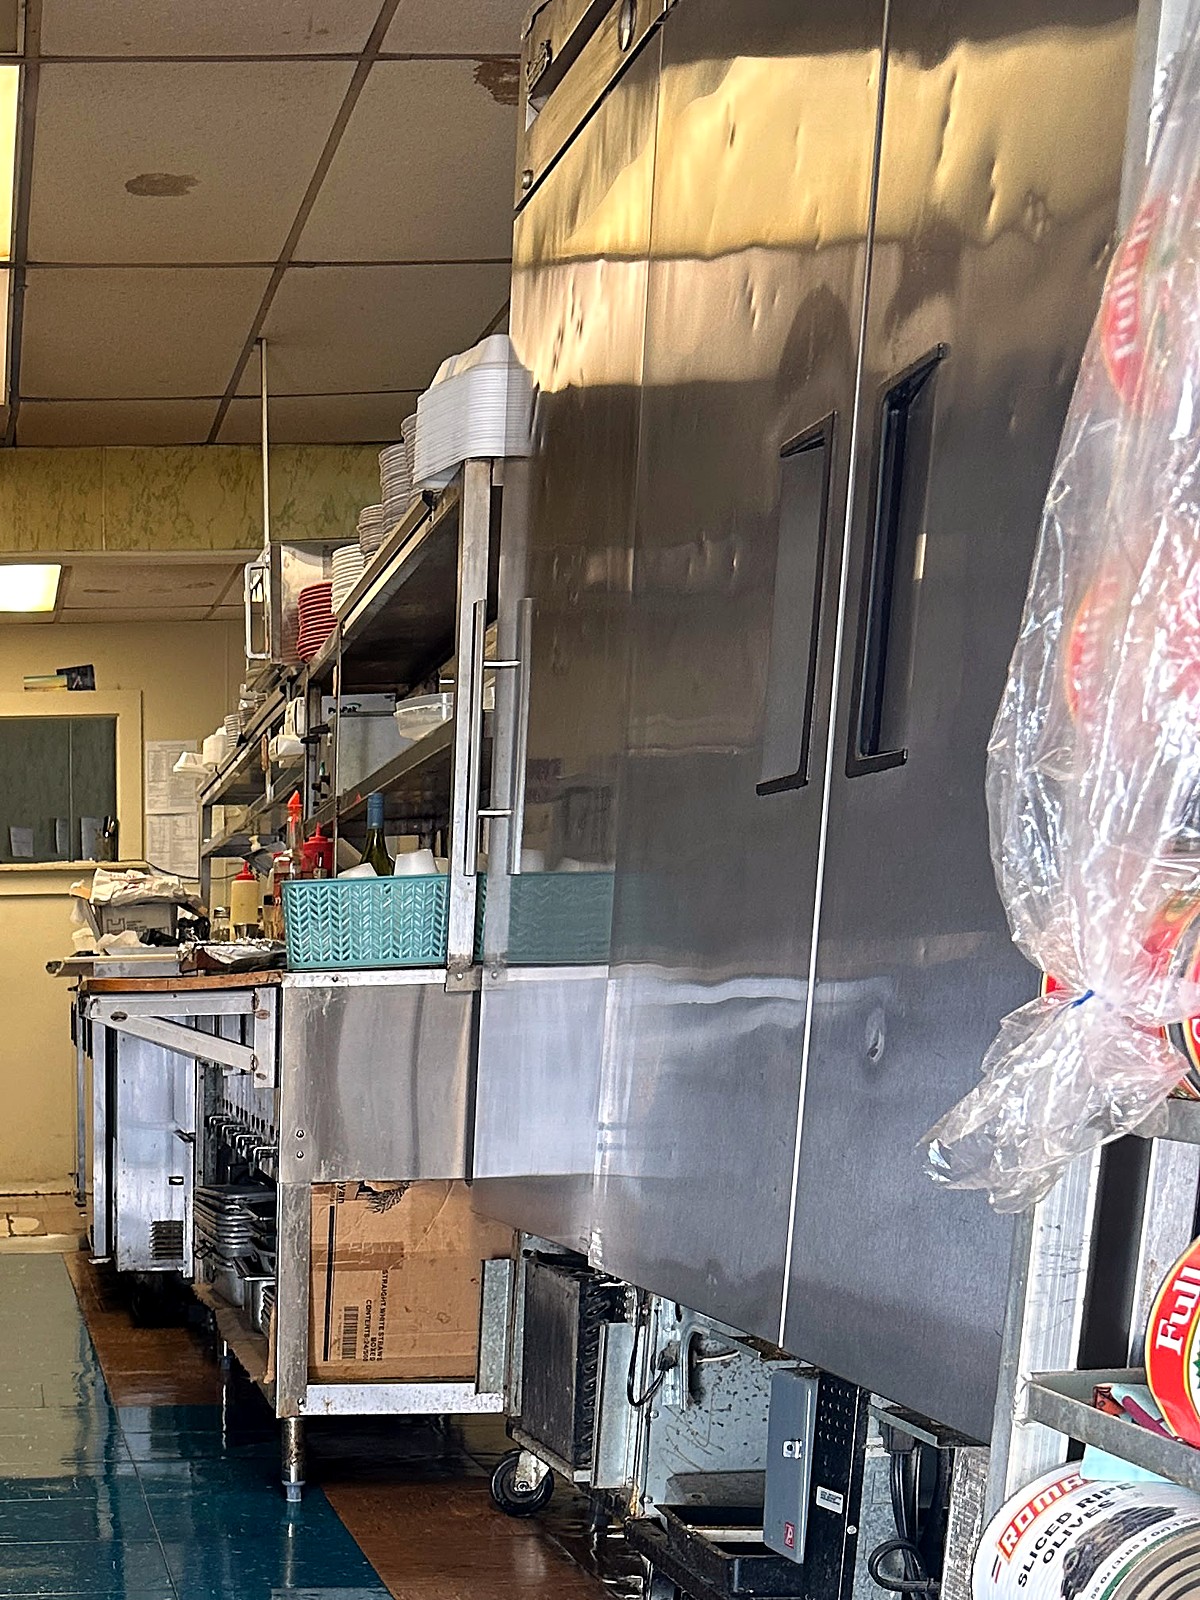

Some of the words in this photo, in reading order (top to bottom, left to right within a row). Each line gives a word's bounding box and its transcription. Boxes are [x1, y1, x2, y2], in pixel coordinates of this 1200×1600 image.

[328, 706, 357, 714] PrPak
[380, 1269, 389, 1306] STRAIGHT
[378, 1307, 386, 1331] WHITE
[1156, 1266, 1200, 1357] Full
[369, 1336, 377, 1361] BOXED
[376, 1332, 385, 1361] STRAWS
[999, 1474, 1085, 1551] ROMA
[1018, 1512, 1072, 1587] SLICED
[1076, 1482, 1135, 1508] RIPE
[1043, 1500, 1115, 1564] OLIVES
